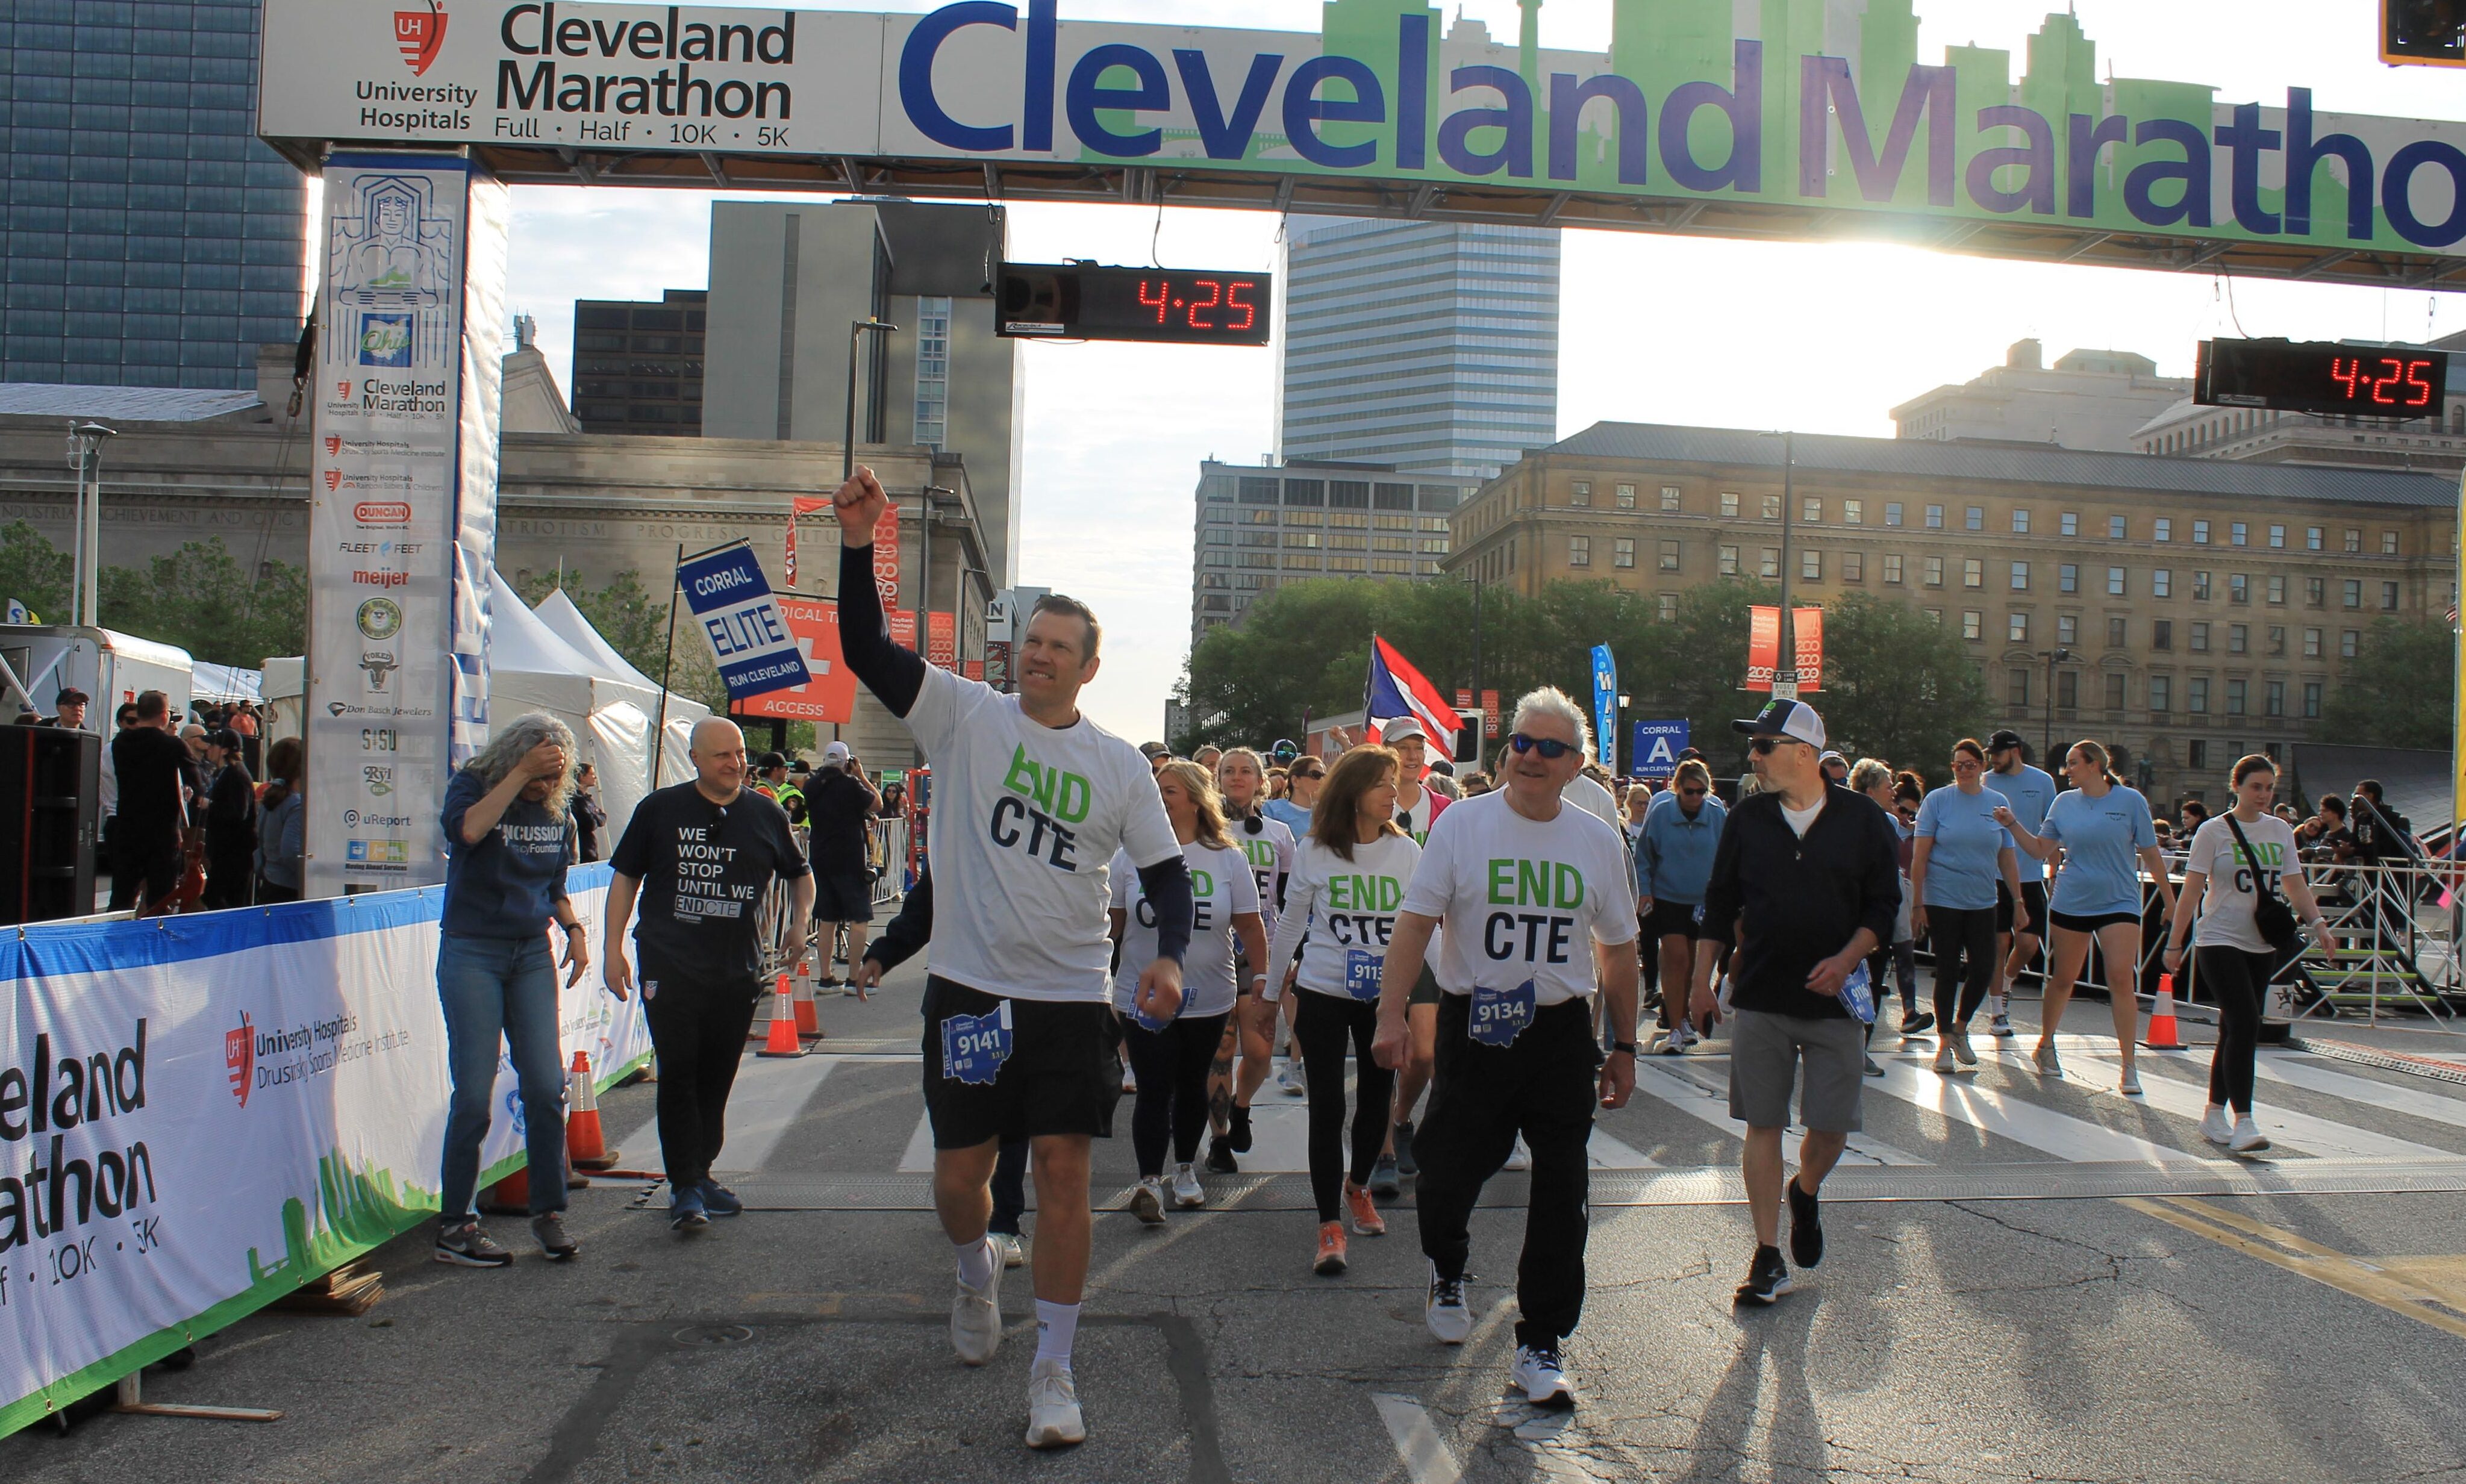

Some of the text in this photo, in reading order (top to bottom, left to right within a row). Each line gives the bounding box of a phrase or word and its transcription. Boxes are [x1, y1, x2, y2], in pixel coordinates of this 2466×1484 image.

[499, 2, 796, 65] Cleveland
[356, 81, 478, 109] University
[496, 60, 792, 119] Marathon
[898, 0, 1754, 193] Cleveland
[360, 108, 471, 132] Hospitals
[494, 117, 791, 148] Full Half 10K 5K
[361, 330, 412, 352] Ohio
[364, 379, 446, 396] Cleveland
[363, 394, 445, 412] Marathon
[376, 440, 410, 449] Hospitals
[2, 505, 86, 520] NDUSTRIA
[208, 511, 242, 524] AND
[360, 508, 406, 517] DUNCAN
[637, 523, 741, 541] PROGRESS
[339, 543, 423, 553] FLEET FEET
[352, 567, 410, 588] meijer
[695, 566, 752, 596] CORRAL
[707, 604, 785, 657] ELITE
[929, 640, 954, 650] 200
[1796, 640, 1820, 652] 200
[929, 652, 954, 663] 200
[1796, 654, 1820, 666] 200
[728, 661, 800, 688] RUN CLEVELAND
[1747, 666, 1774, 679] 200
[1796, 667, 1820, 679] 200
[368, 706, 392, 715] Basch
[393, 707, 432, 716] Jewelers
[764, 700, 824, 717] ACCESS
[1643, 726, 1682, 735] CORRAL
[1647, 737, 1674, 763] A
[1003, 742, 1091, 824] END
[364, 814, 412, 828] uReport
[678, 828, 707, 841] WE
[990, 796, 1077, 872] CTE
[678, 844, 737, 862] WON'T
[678, 862, 723, 878] STOP
[678, 878, 754, 899] UNTIL WE
[1329, 874, 1402, 912] END
[1488, 859, 1585, 910] END
[1135, 897, 1212, 931] CE
[1329, 914, 1395, 946] CTE
[1484, 911, 1574, 964] CTE
[1850, 984, 1870, 1002] 9116
[1478, 1001, 1526, 1021] 9134
[256, 1011, 357, 1057] University Hospitals
[958, 1029, 1000, 1056] 9141
[309, 1050, 332, 1075] Sports
[334, 1038, 373, 1065] Medicine
[375, 1028, 409, 1053] Institute
[49, 1235, 96, 1286] 10K
[137, 1216, 161, 1256] 5K
